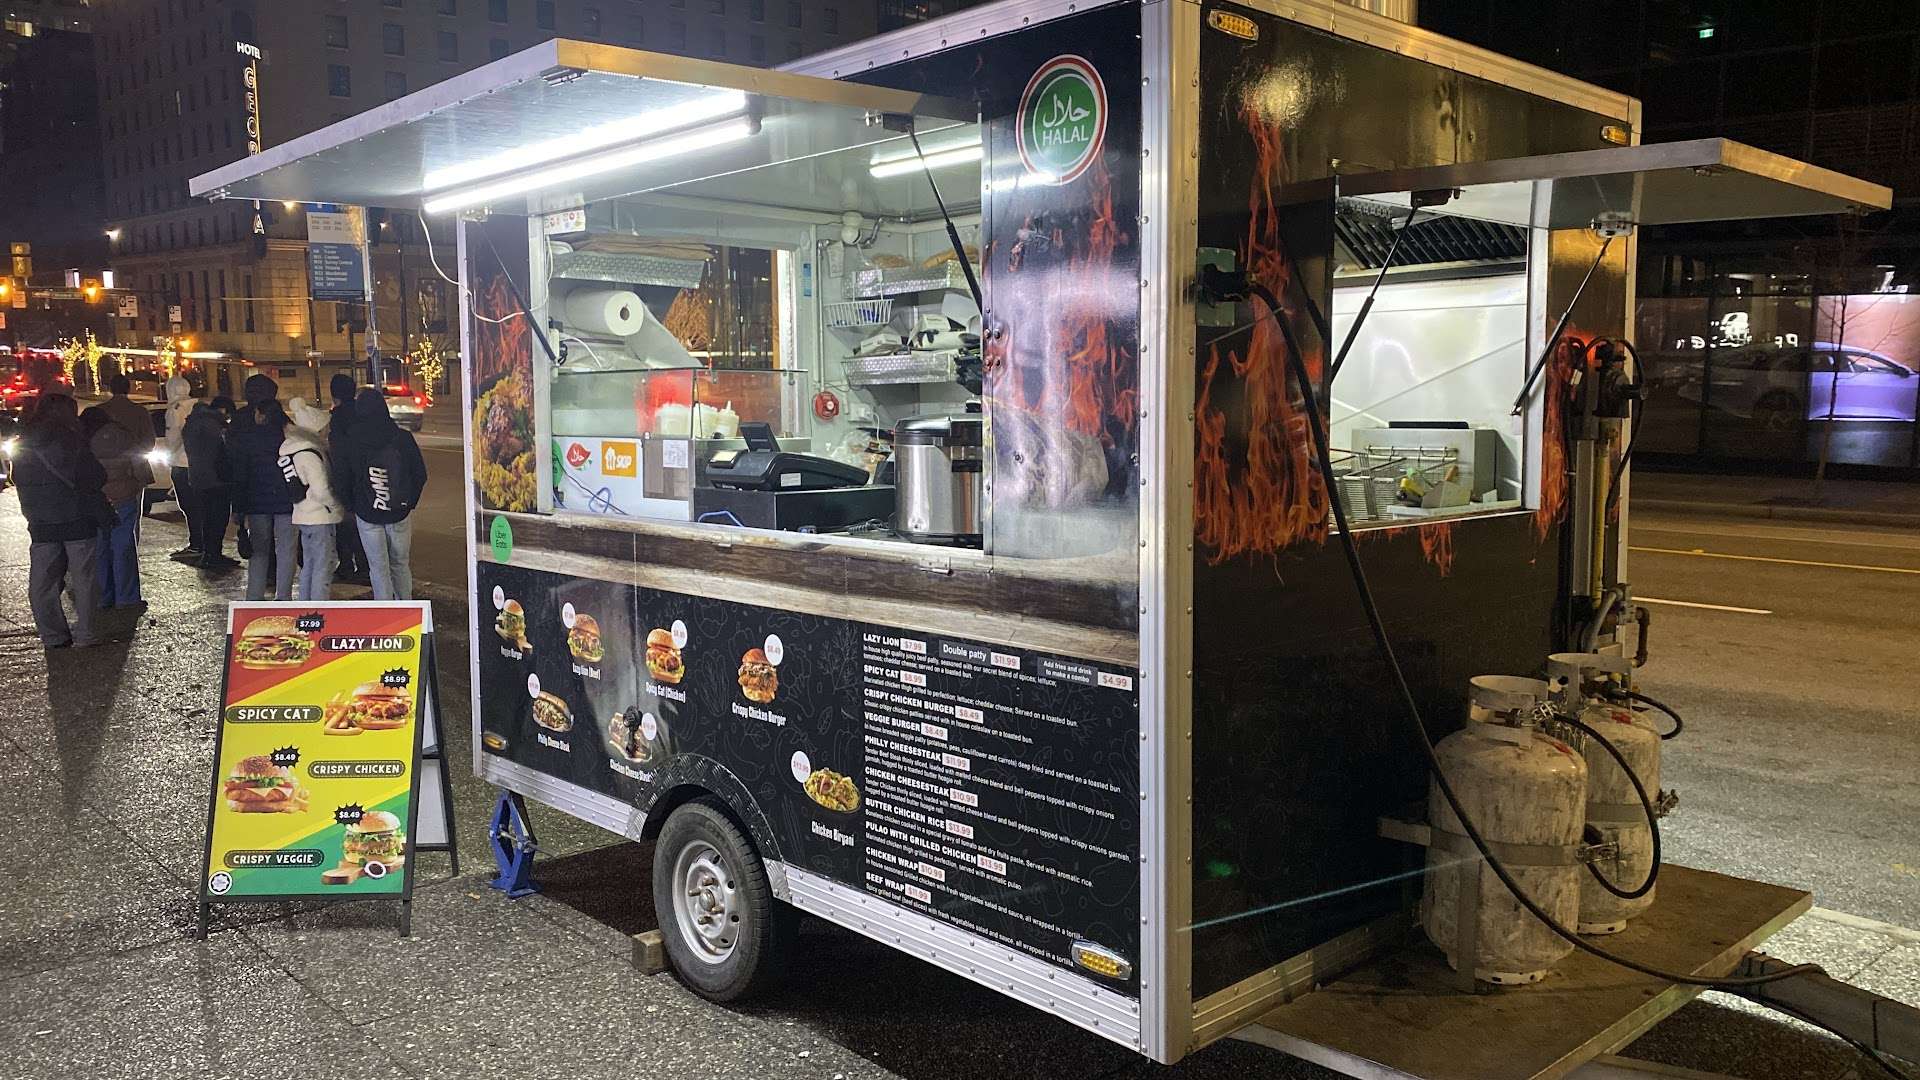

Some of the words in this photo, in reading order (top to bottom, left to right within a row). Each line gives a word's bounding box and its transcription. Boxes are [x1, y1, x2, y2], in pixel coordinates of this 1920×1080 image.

[236, 42, 262, 60] HOTEL
[1042, 94, 1090, 128] حلال
[1042, 125, 1089, 146] HALAL
[244, 67, 265, 235] GEORA
[368, 466, 392, 511] PUMA
[300, 620, 320, 628] $7.99
[332, 638, 364, 650] LAZY
[372, 638, 402, 649] LION
[863, 632, 881, 644] LAZY
[882, 636, 900, 647] LION
[905, 641, 922, 651] $7.99
[943, 644, 968, 658] Double
[969, 648, 986, 661] patty
[995, 656, 1016, 667] $11.99
[1055, 663, 1066, 671] fries
[1078, 667, 1092, 675] drink
[864, 664, 884, 676] SPICY
[885, 668, 899, 679] CAT
[904, 673, 922, 684] $8.99
[998, 670, 1012, 678] blend
[1052, 670, 1066, 679] make
[1071, 674, 1089, 683] combo
[384, 675, 406, 684] $8.99
[1103, 675, 1127, 688] $4.99
[864, 687, 889, 701] CRISPY
[890, 693, 922, 708] CHICKEN
[924, 700, 954, 716] BURGER
[238, 709, 278, 720] SPICY
[284, 709, 310, 720] CAT
[732, 702, 748, 718] Crispy
[749, 706, 767, 721] Chicken
[768, 711, 786, 726] Burger
[864, 711, 890, 725] VEGGIE
[892, 718, 921, 732] BURGER
[959, 709, 979, 720] $8.49
[1015, 708, 1032, 718] Served
[1046, 714, 1065, 725] toasted
[925, 726, 944, 738] $8.49
[864, 734, 889, 748] PHILLY
[890, 741, 941, 762] CHEESESTEAK
[275, 752, 295, 761] $8.49
[945, 756, 966, 768] $11.99
[313, 764, 350, 774] CRISPY
[355, 764, 400, 774] CHICKEN
[1018, 761, 1031, 772] deep
[1032, 765, 1044, 774] fried
[1045, 768, 1055, 777] and
[1055, 770, 1074, 782] served
[1088, 779, 1108, 790] toasted
[865, 766, 896, 782] CHICKEN
[897, 775, 949, 798] CHEESESTEAK
[952, 791, 976, 804] $10.99
[972, 775, 989, 786] cheese
[990, 779, 1003, 790] blend
[1004, 783, 1013, 792] and
[1024, 790, 1045, 802] peppers
[1046, 795, 1065, 808] topped
[1066, 800, 1077, 810] with
[1078, 803, 1095, 816] crispy
[1096, 808, 1114, 820] onions
[339, 811, 360, 819] $8.49
[865, 797, 892, 813] BUTTER
[894, 806, 926, 824] CHICKEN
[928, 816, 945, 830] RICE
[812, 821, 832, 839] Chicken
[834, 829, 854, 846] Biryani
[948, 823, 970, 837] $13.99
[1018, 824, 1039, 836] peppers
[1040, 829, 1058, 842] topped
[1059, 834, 1070, 844] with
[1071, 838, 1088, 851] crispy
[866, 820, 888, 836] PULAO
[890, 828, 908, 842] WITH
[910, 835, 940, 853] GRILLED
[942, 845, 976, 865] CHICKEN
[233, 854, 272, 864] CRISPY
[276, 854, 314, 864] VEGGIE
[866, 846, 897, 864] CHICKEN
[898, 857, 918, 872] WRAP
[980, 858, 1003, 873] $13.99
[921, 866, 943, 880] $10.99
[1026, 860, 1044, 872] Served
[1045, 866, 1056, 876] with
[1057, 870, 1080, 883] aromatic
[866, 871, 884, 885] BEEF
[885, 878, 904, 893] WRAP
[908, 887, 928, 901] $11.99
[998, 904, 1007, 914] and
[1032, 917, 1055, 932] wrapped
[1023, 941, 1045, 957] wrapped
